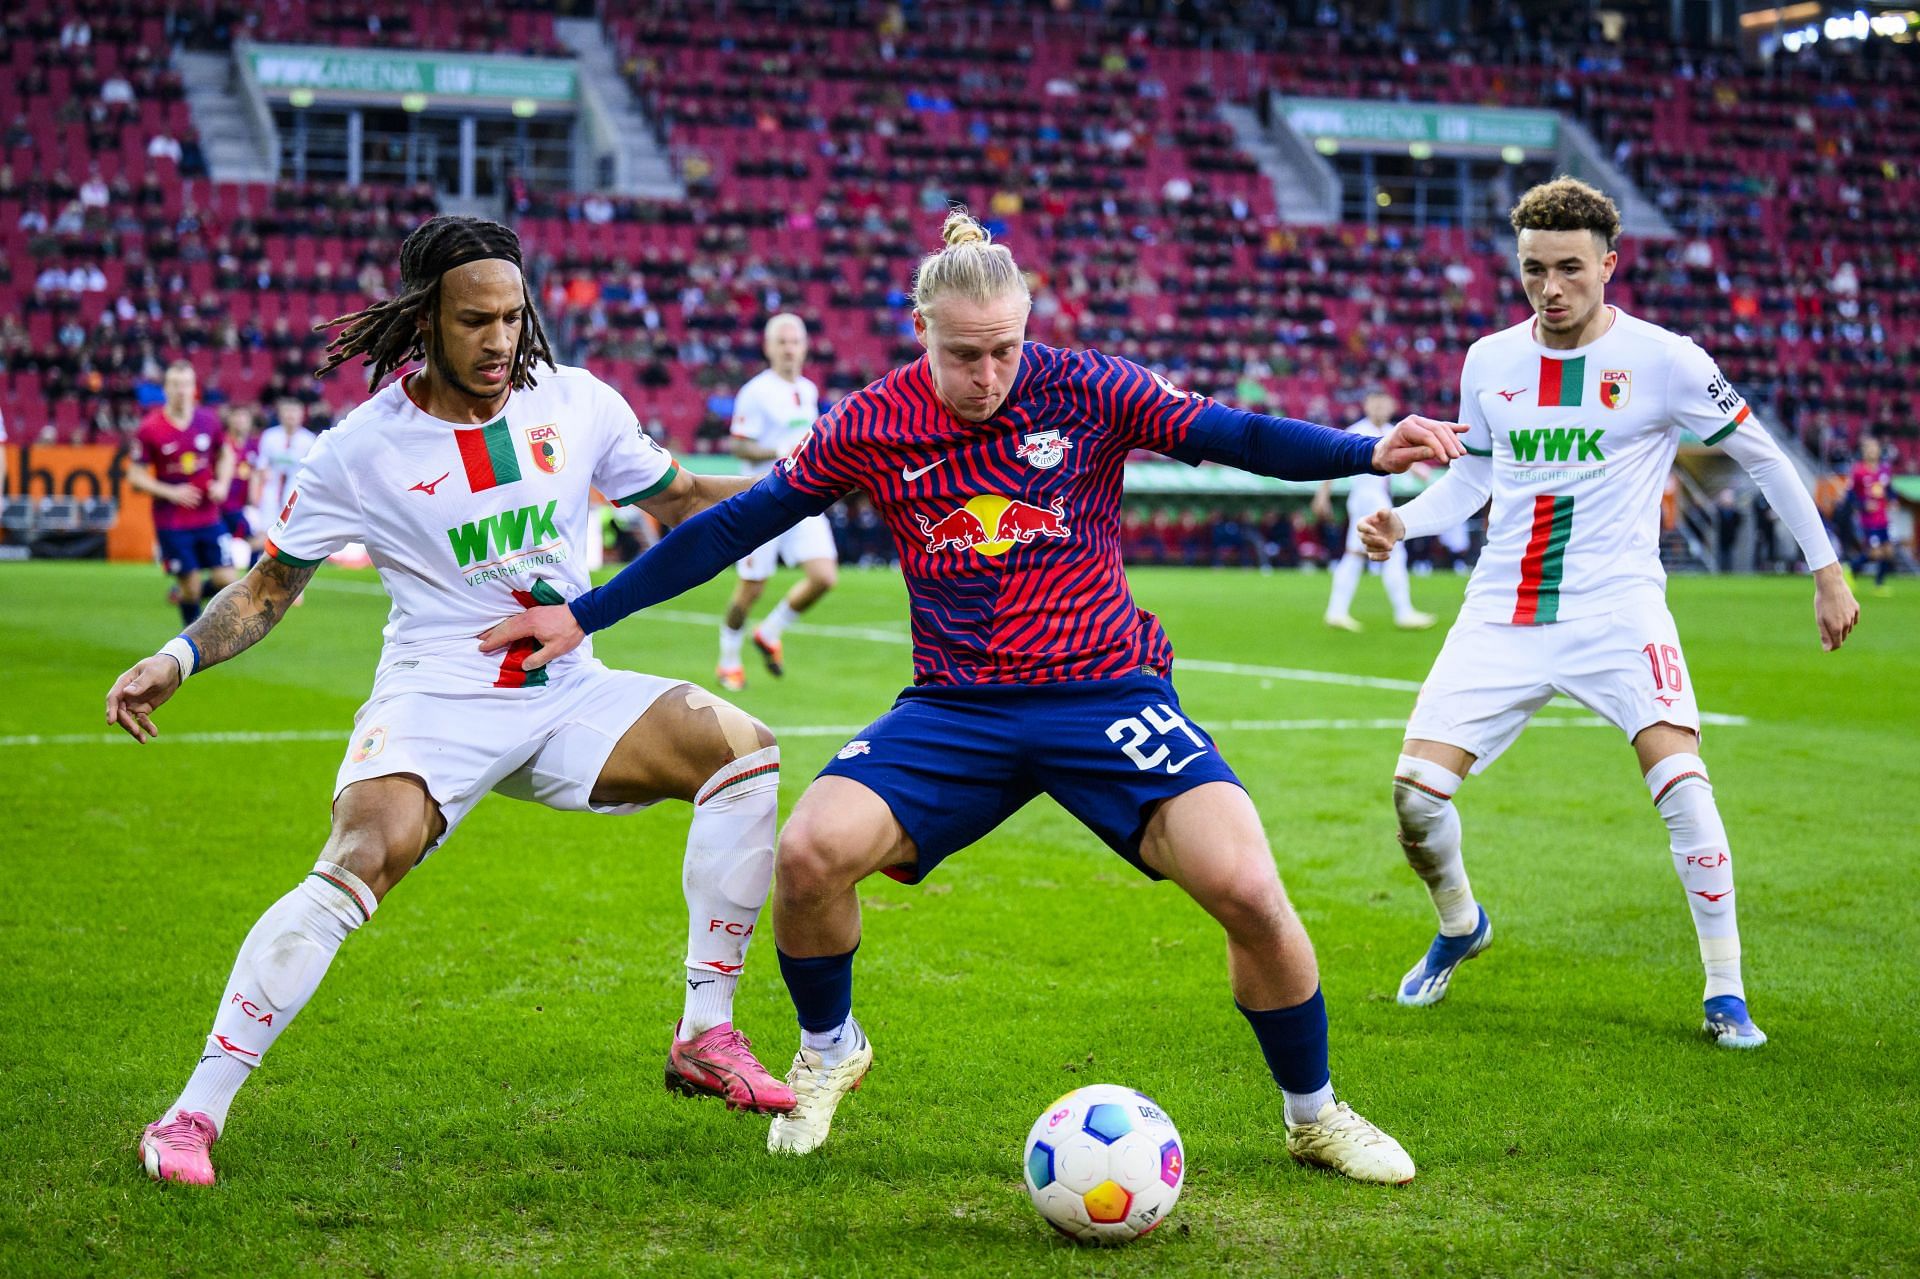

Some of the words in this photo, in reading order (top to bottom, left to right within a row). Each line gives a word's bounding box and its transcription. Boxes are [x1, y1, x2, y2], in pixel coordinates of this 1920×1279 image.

[1508, 428, 1606, 461] WWK
[1, 436, 131, 510] hof
[1513, 470, 1606, 481] VERSICHERUNGEN
[447, 499, 560, 568] WWK
[465, 550, 567, 587] VERSICHERUNGEN
[1642, 643, 1682, 692] 16
[1105, 704, 1206, 771] 24
[1687, 853, 1728, 868] FCA
[709, 919, 754, 936] FCA
[231, 992, 273, 1027] FCA
